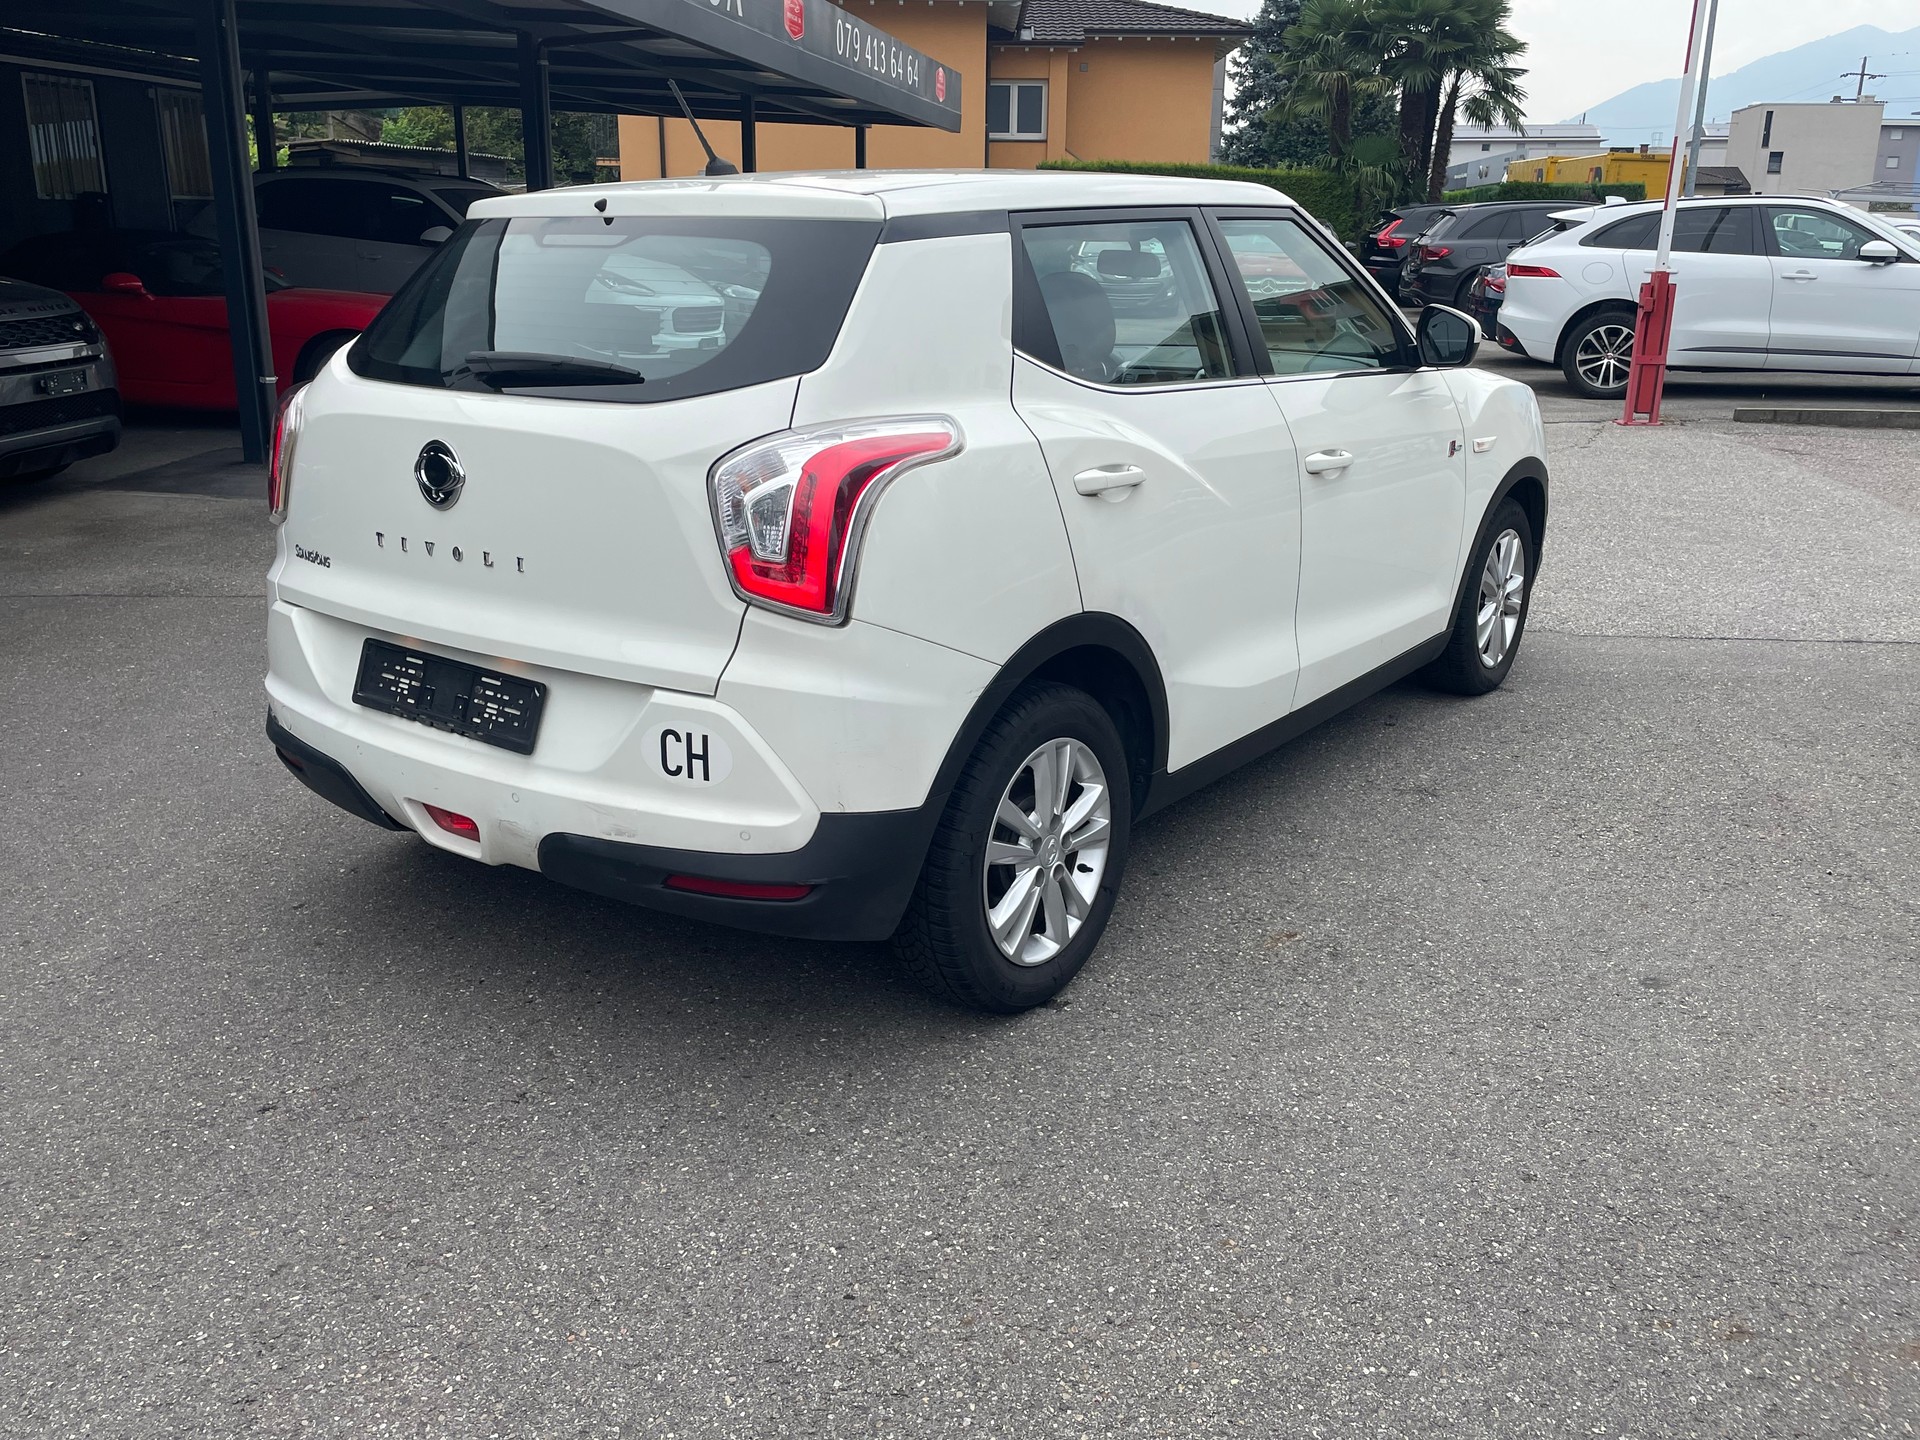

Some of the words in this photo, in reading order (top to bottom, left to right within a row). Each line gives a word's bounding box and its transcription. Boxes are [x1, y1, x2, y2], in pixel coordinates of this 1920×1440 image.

[836, 18, 860, 62] 079
[865, 34, 886, 74] 413
[890, 46, 904, 81] 64
[907, 54, 920, 88] 64
[375, 531, 525, 573] TIVOLI
[660, 728, 710, 782] CH
